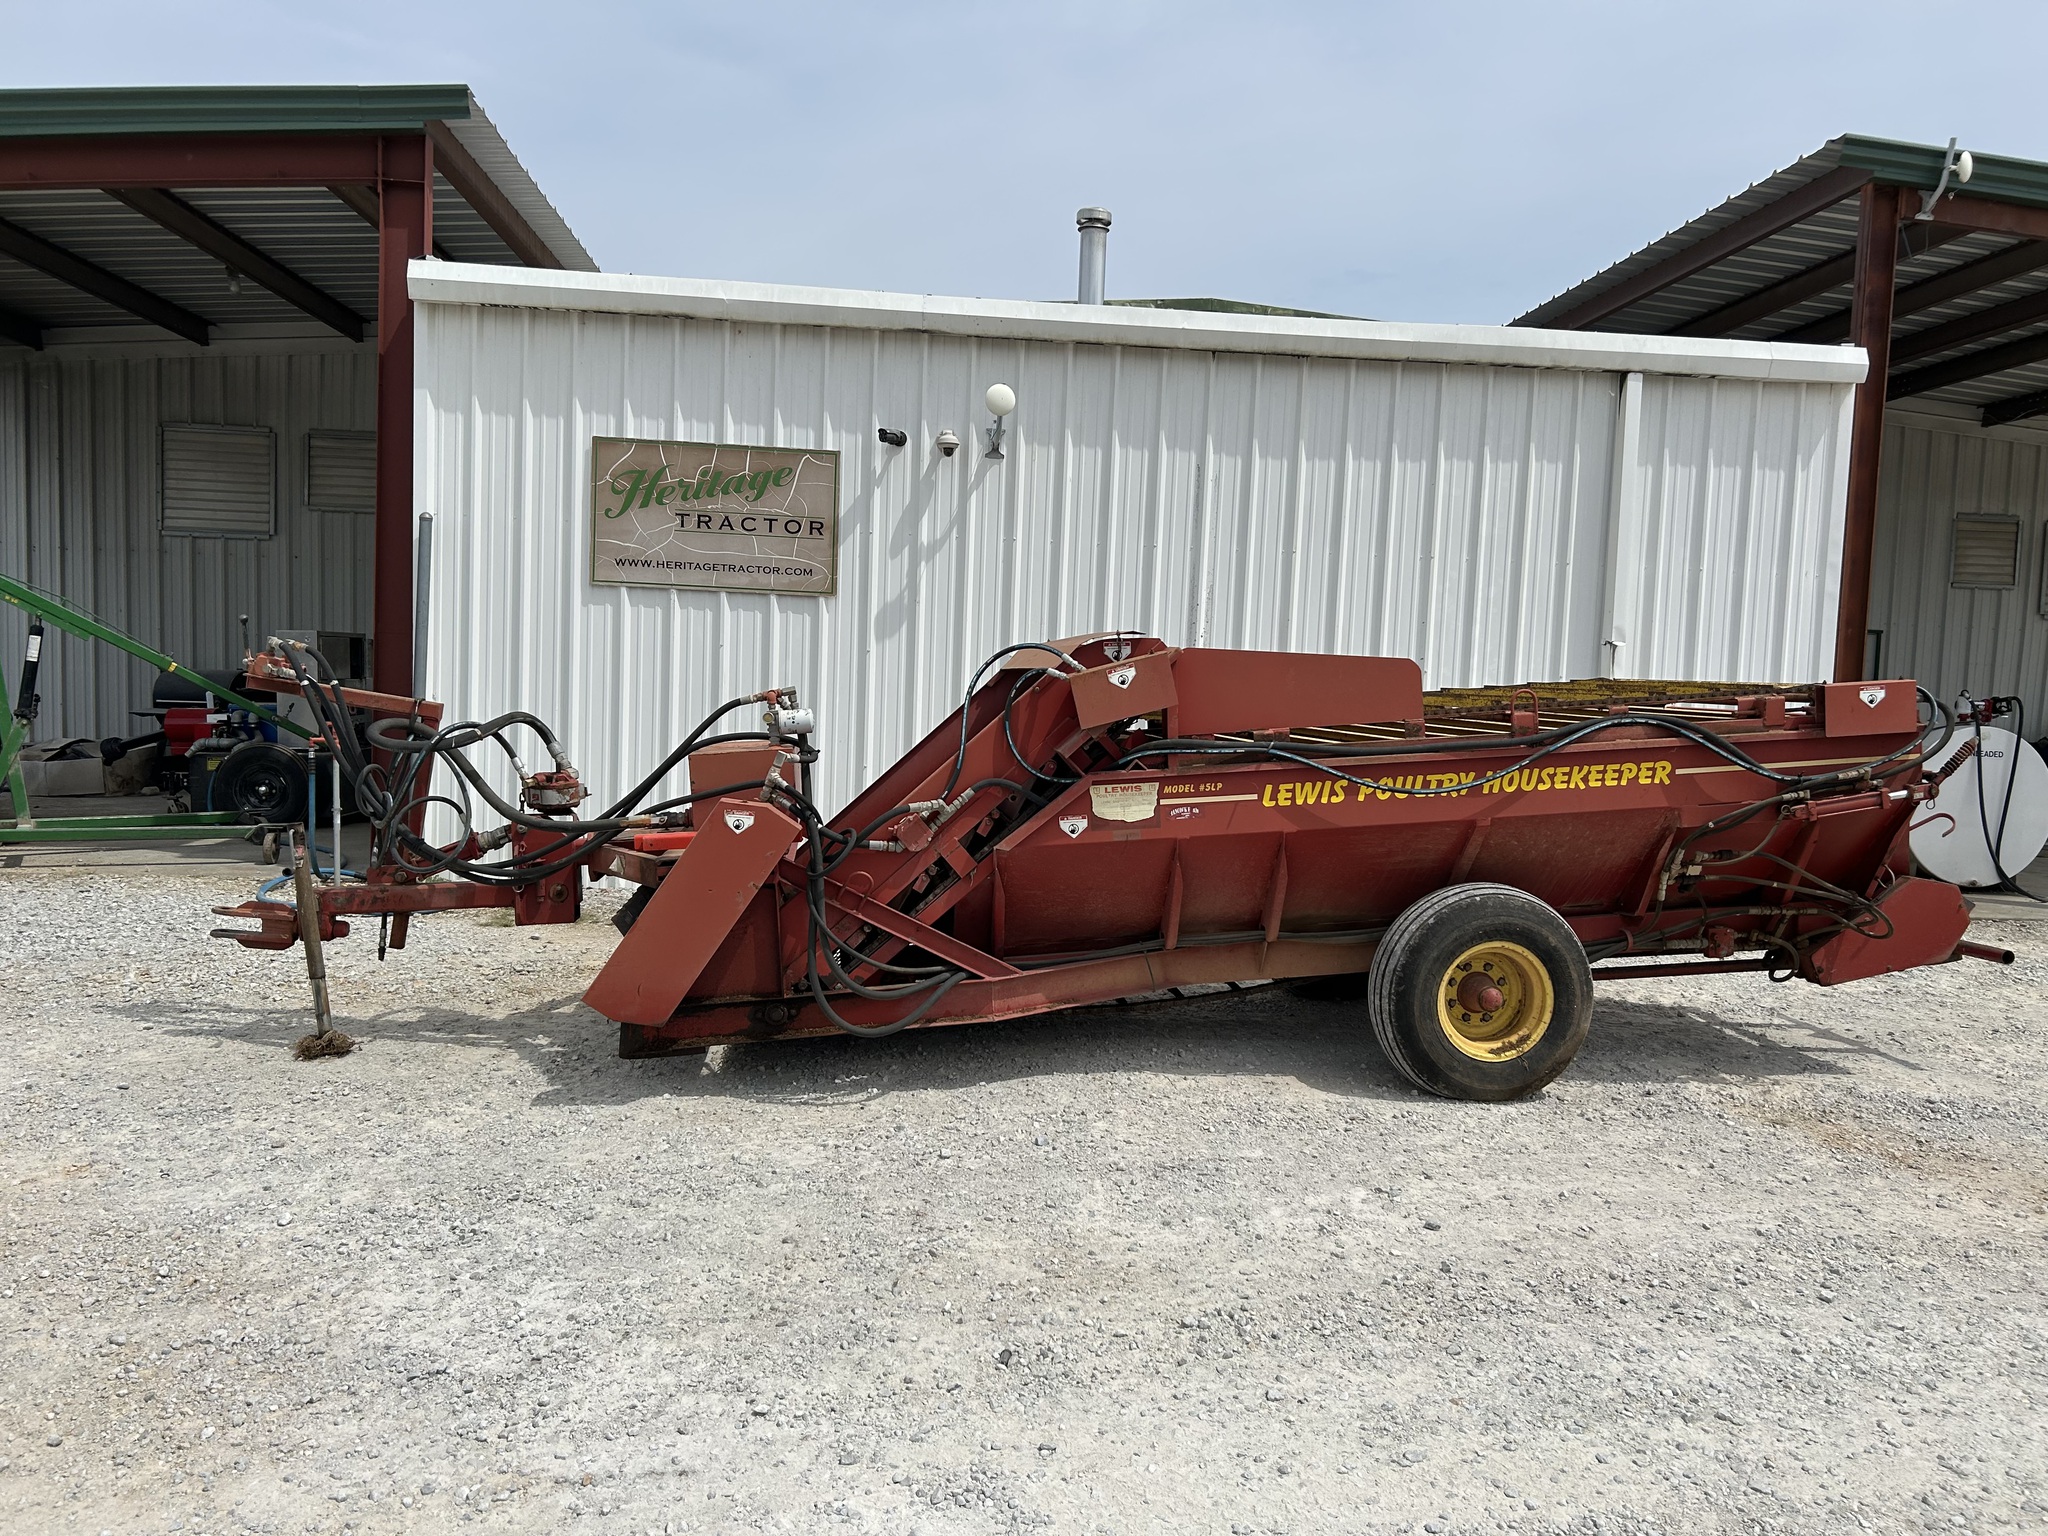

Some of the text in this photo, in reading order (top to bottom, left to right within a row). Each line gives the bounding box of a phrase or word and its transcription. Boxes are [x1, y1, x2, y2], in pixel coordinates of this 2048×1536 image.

[604, 463, 794, 519] Heritage
[675, 512, 825, 536] TRACTOR
[615, 557, 813, 577] WWW.HERITAGETRACTOR.COM
[1104, 785, 1143, 794] LEWIS
[1163, 783, 1195, 794] MODEL
[1262, 760, 1672, 807] LEWIS POULTRY HOUSEKEEPER
